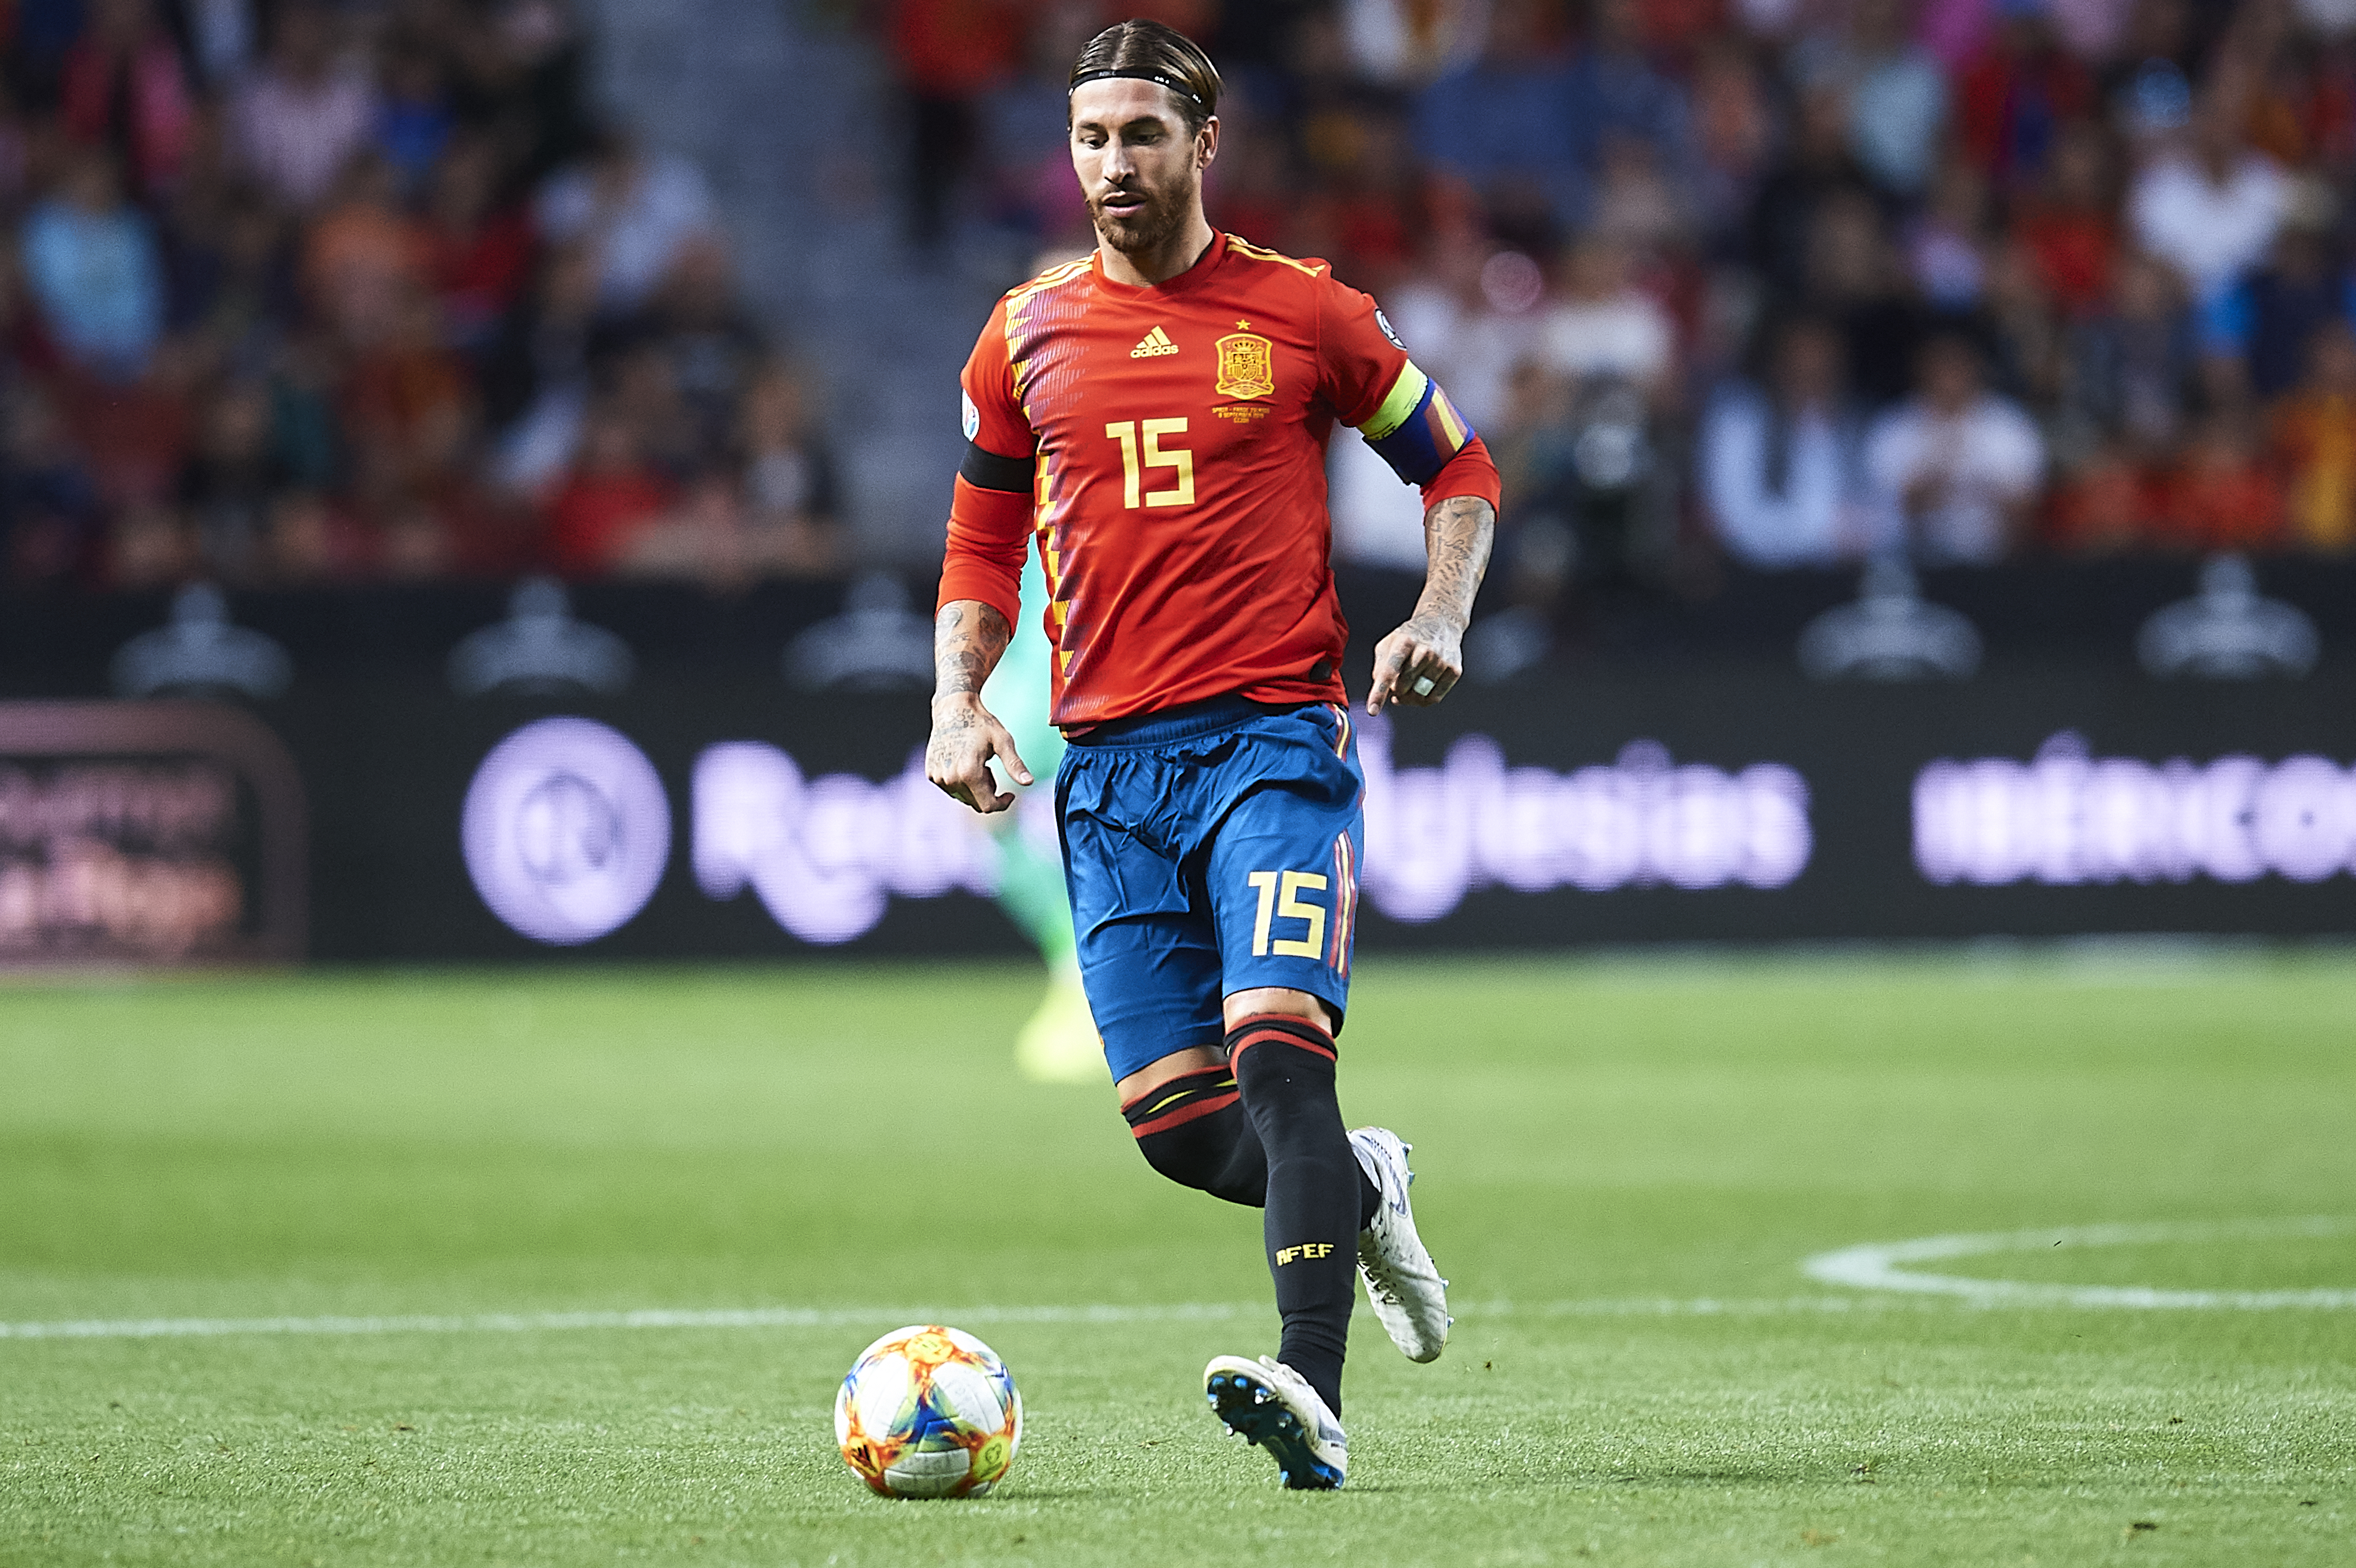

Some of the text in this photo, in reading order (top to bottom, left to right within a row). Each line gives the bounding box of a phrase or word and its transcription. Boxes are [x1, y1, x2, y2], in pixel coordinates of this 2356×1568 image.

[1130, 345, 1179, 358] adidas
[1106, 417, 1195, 509] 15
[1911, 728, 2356, 886] IBÉRICO
[1248, 871, 1327, 960] 15
